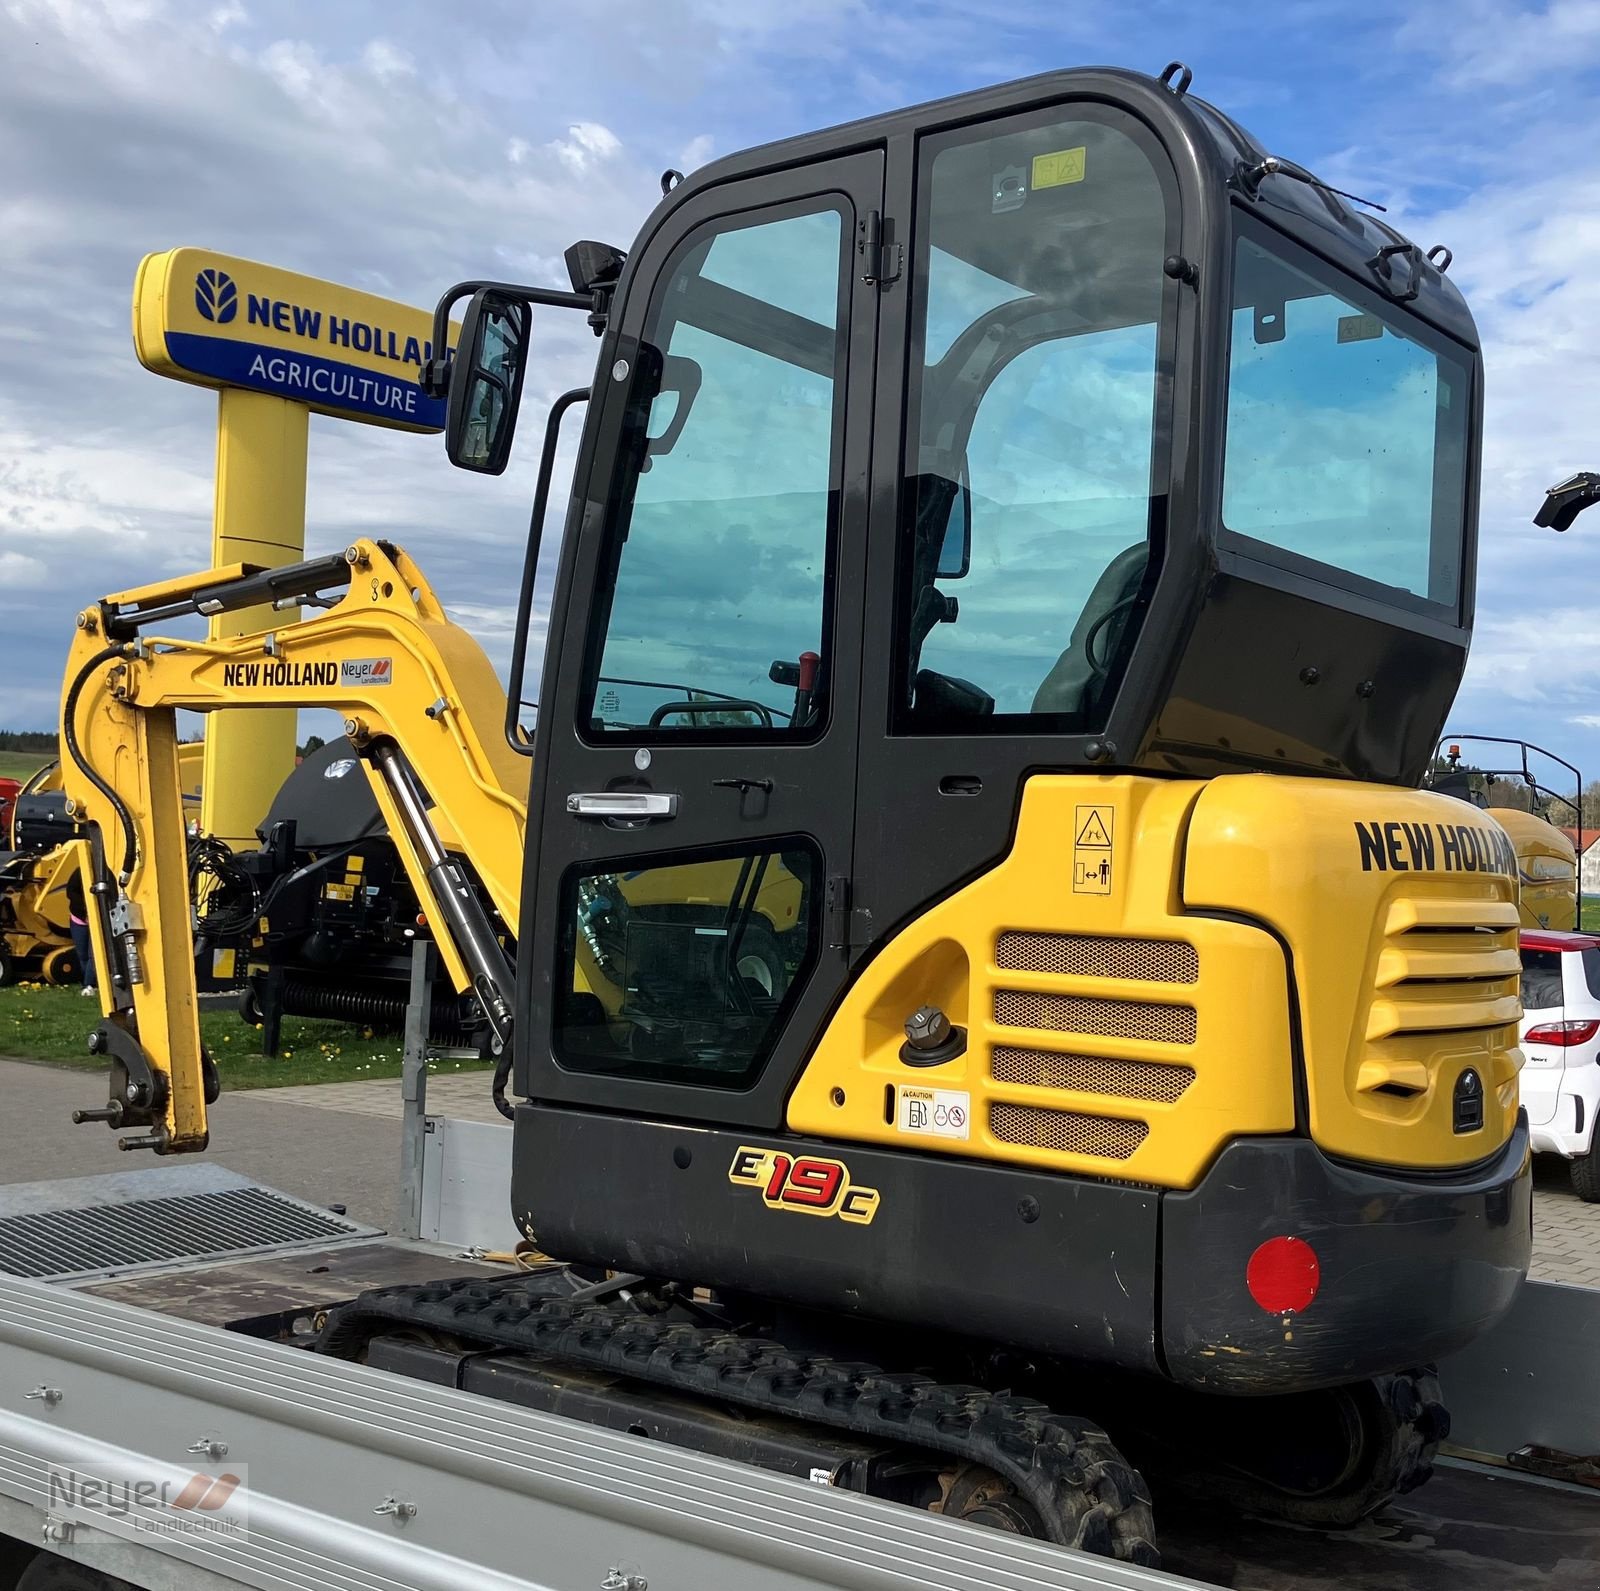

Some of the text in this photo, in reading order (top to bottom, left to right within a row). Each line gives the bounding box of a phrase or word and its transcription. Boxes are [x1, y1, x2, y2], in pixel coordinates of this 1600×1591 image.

[248, 294, 321, 339] NEW
[249, 354, 416, 413] AGRICULTURE
[224, 662, 338, 687] NEW HOLLAND
[341, 662, 372, 678] Neyer
[1354, 821, 1435, 872] NEW
[909, 1091, 933, 1100] CAUTION
